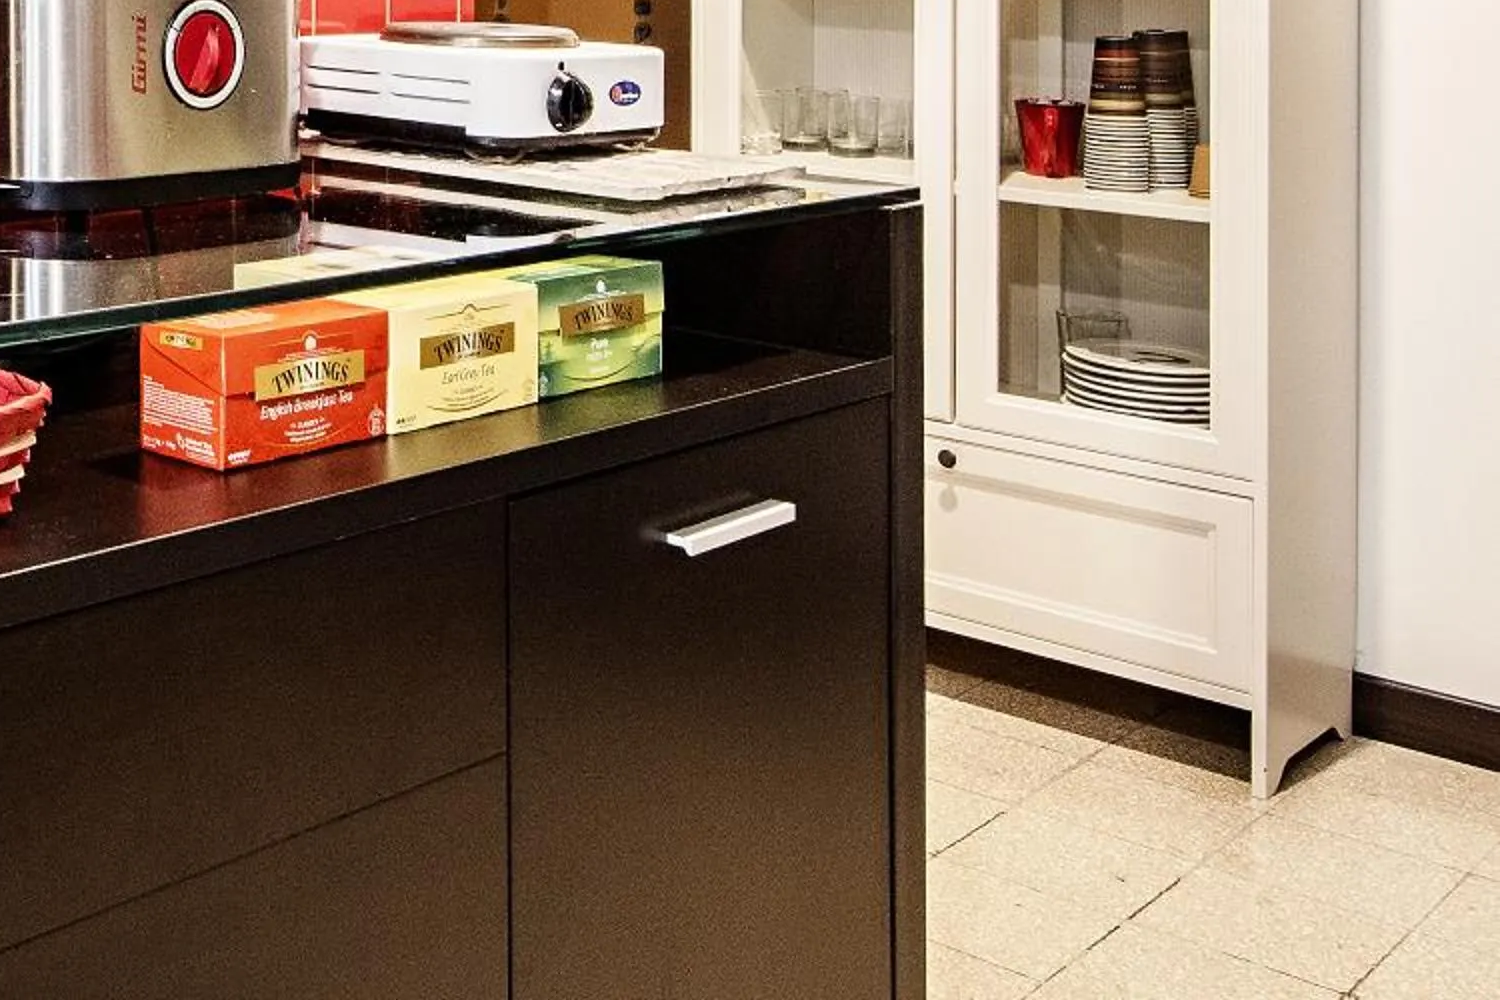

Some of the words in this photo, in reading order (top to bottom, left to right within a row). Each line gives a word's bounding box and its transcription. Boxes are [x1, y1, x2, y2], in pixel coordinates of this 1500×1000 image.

[574, 302, 634, 330] TWININGS
[433, 331, 503, 362] TWININGS
[271, 359, 351, 394] TWININGS
